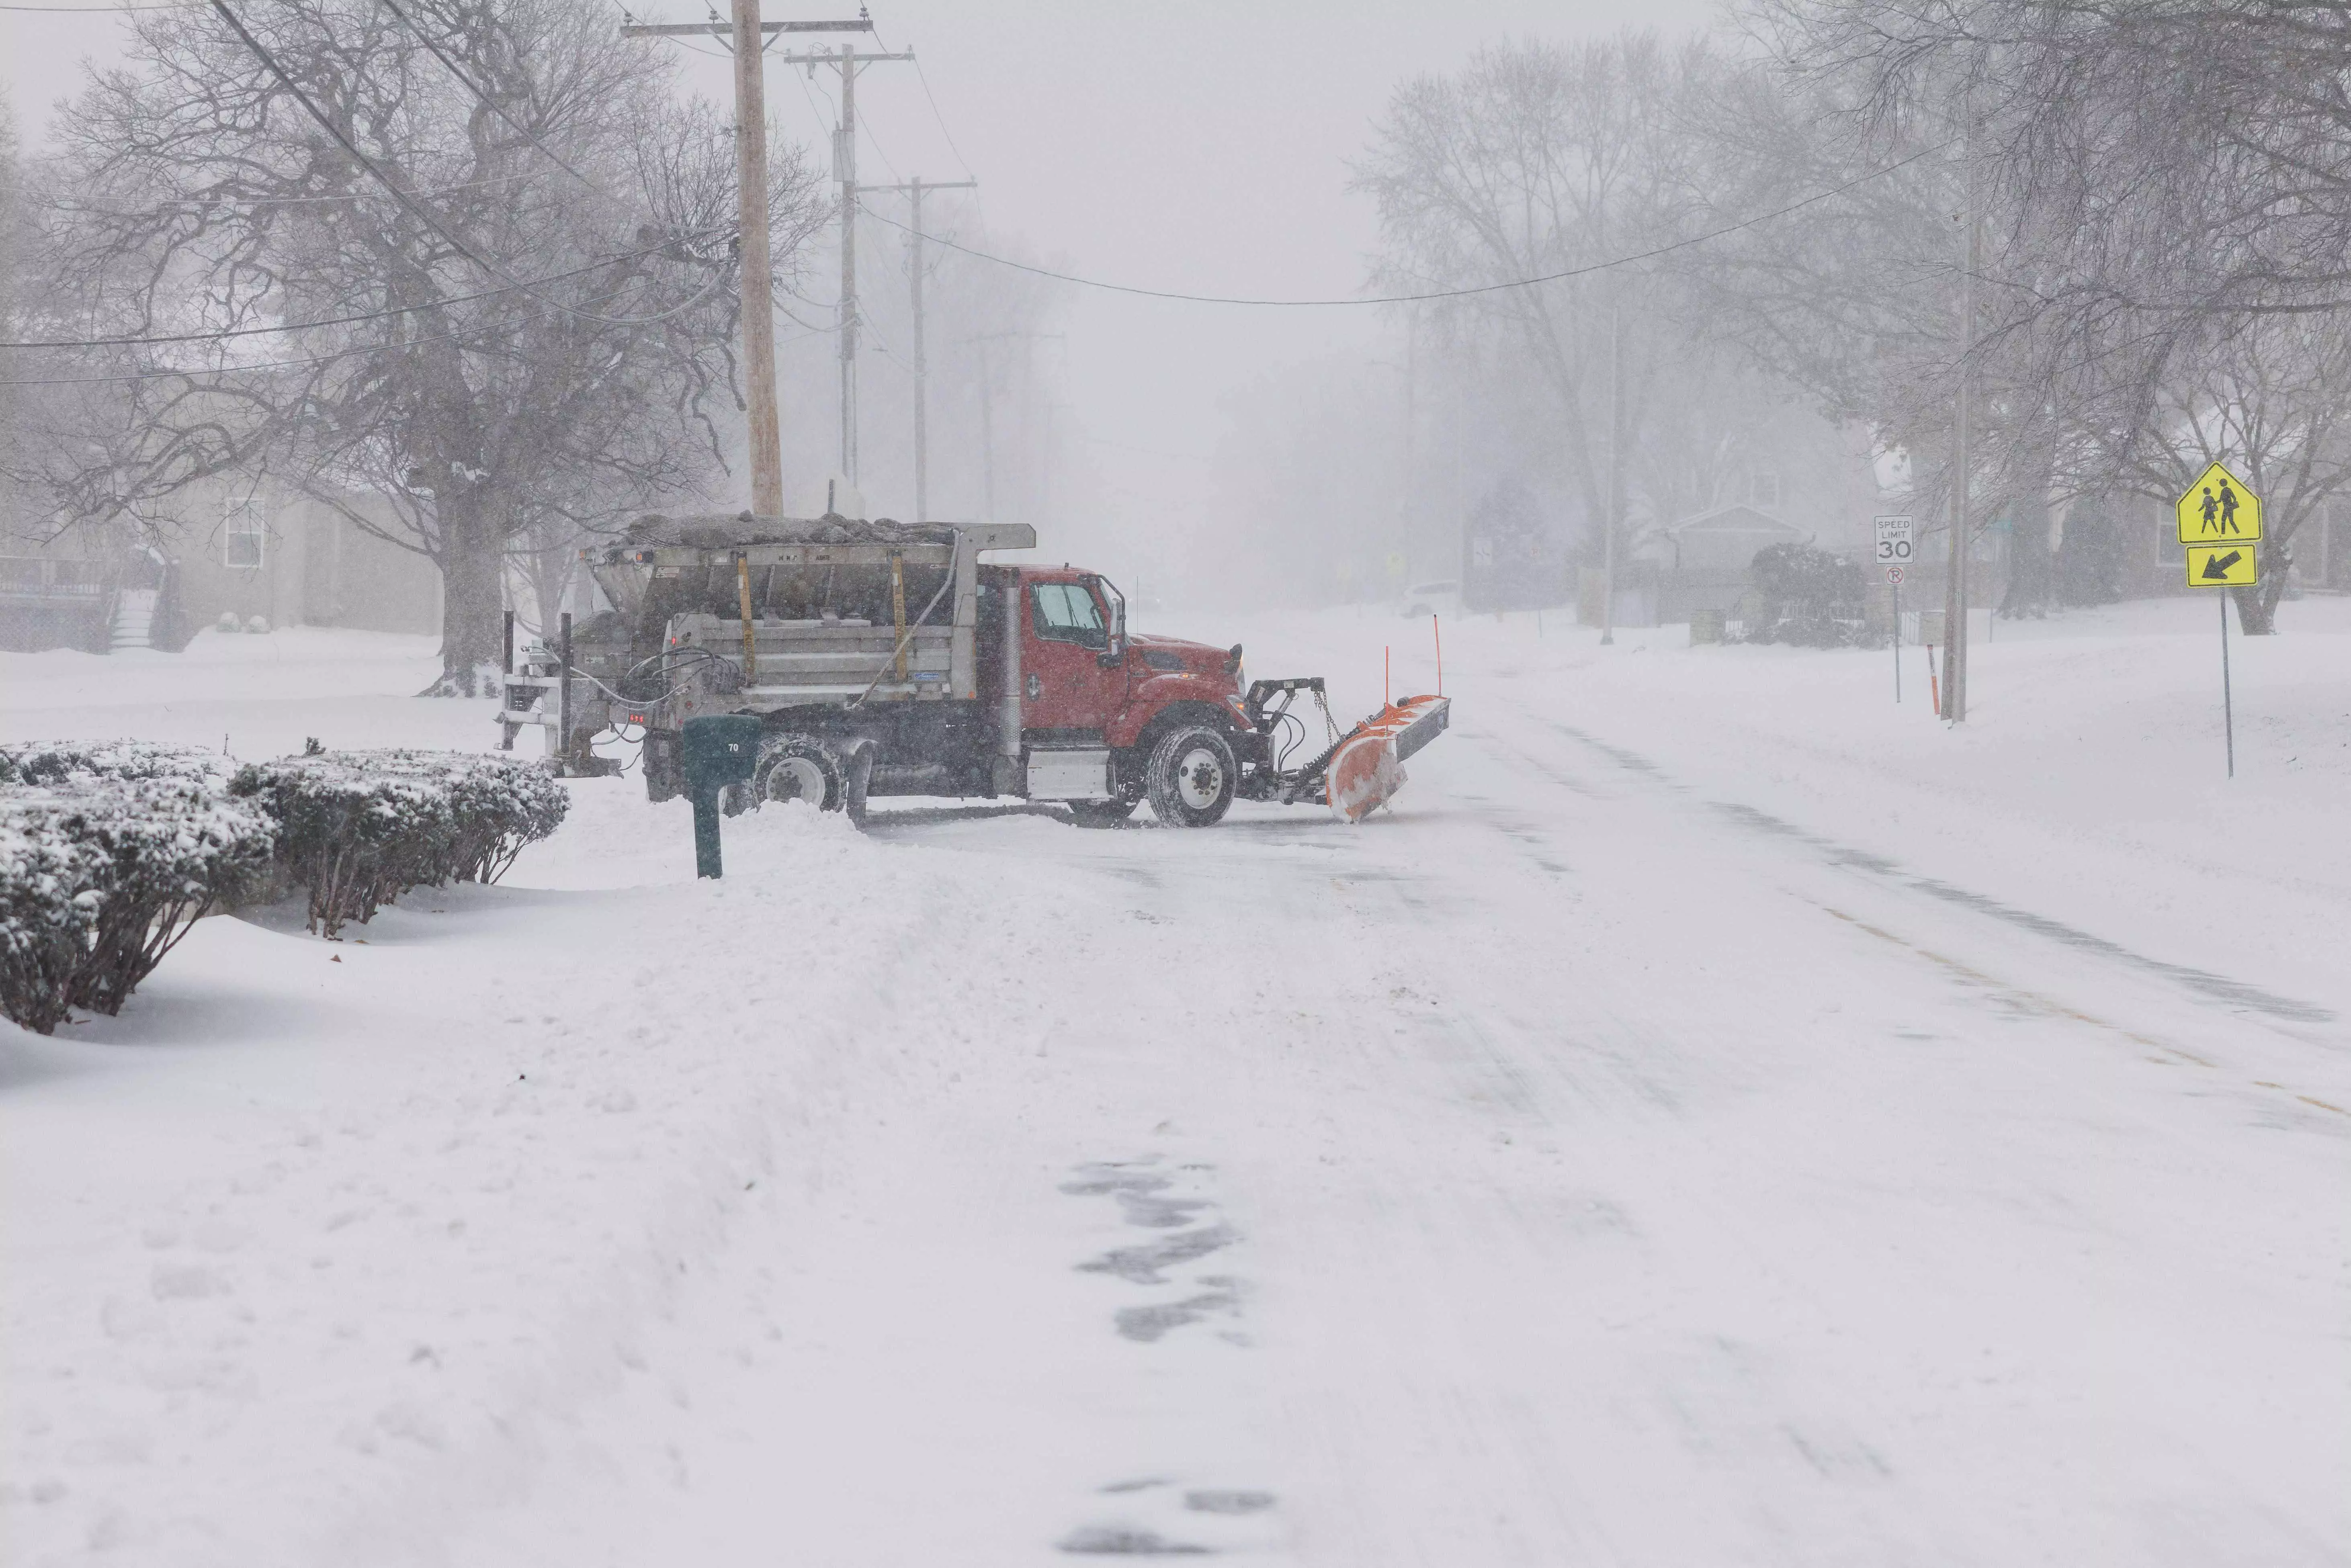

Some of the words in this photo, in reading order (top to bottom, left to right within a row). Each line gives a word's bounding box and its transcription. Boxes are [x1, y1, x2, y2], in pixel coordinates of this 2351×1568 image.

[1882, 531, 1906, 539] LIMIT
[1878, 540, 1911, 559] 30
[728, 743, 739, 752] 70
